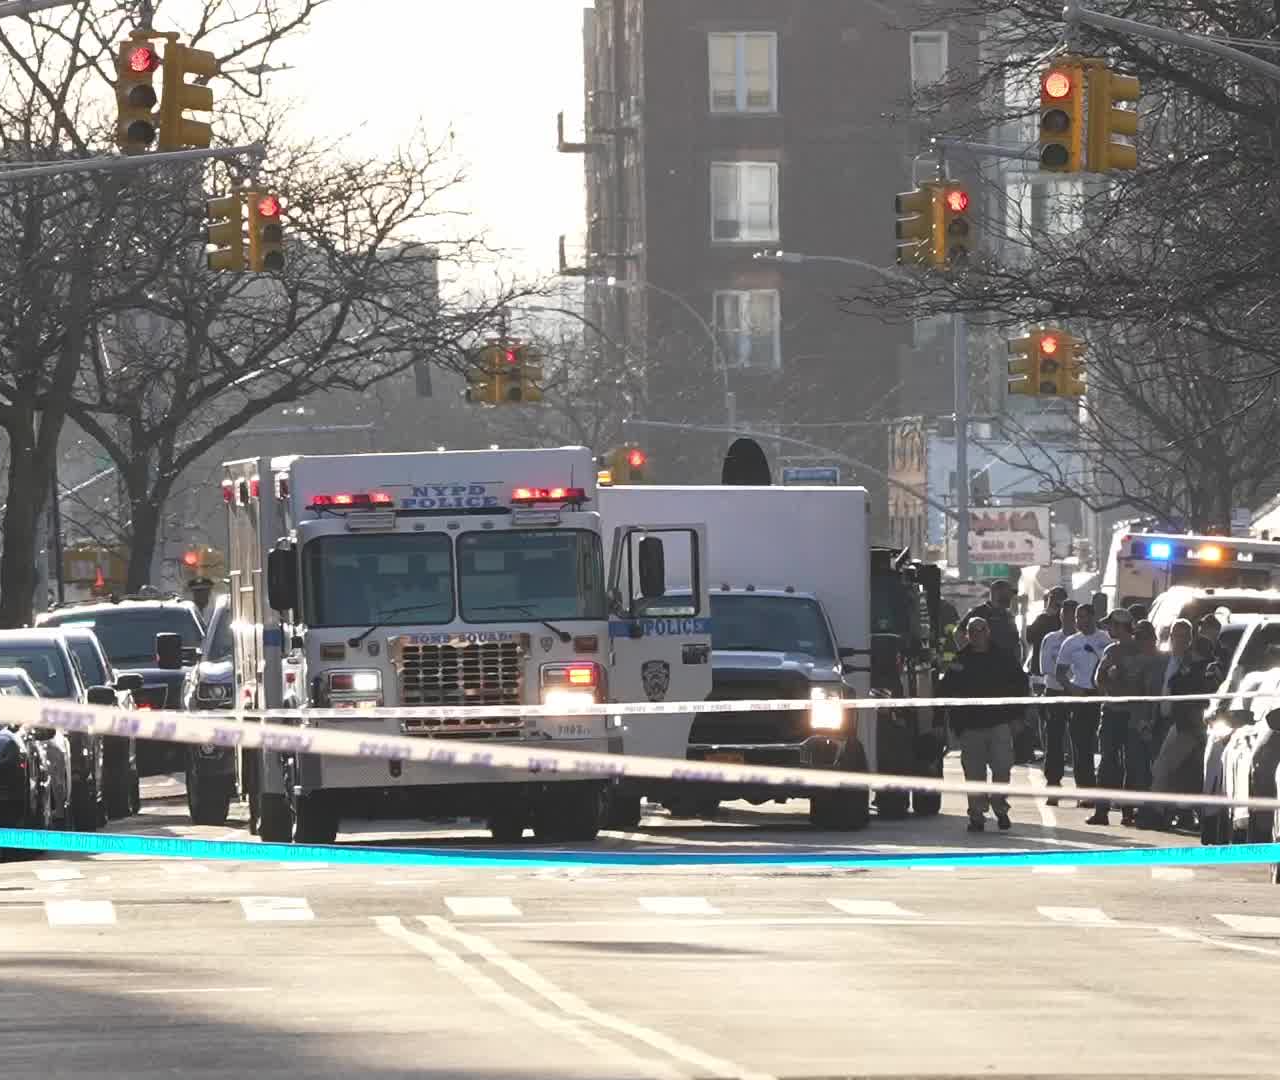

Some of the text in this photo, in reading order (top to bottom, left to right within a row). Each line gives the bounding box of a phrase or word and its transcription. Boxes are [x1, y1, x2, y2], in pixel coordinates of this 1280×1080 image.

[410, 485, 486, 497] NYPD
[400, 496, 498, 508] POLICE
[644, 619, 705, 635] POLICE
